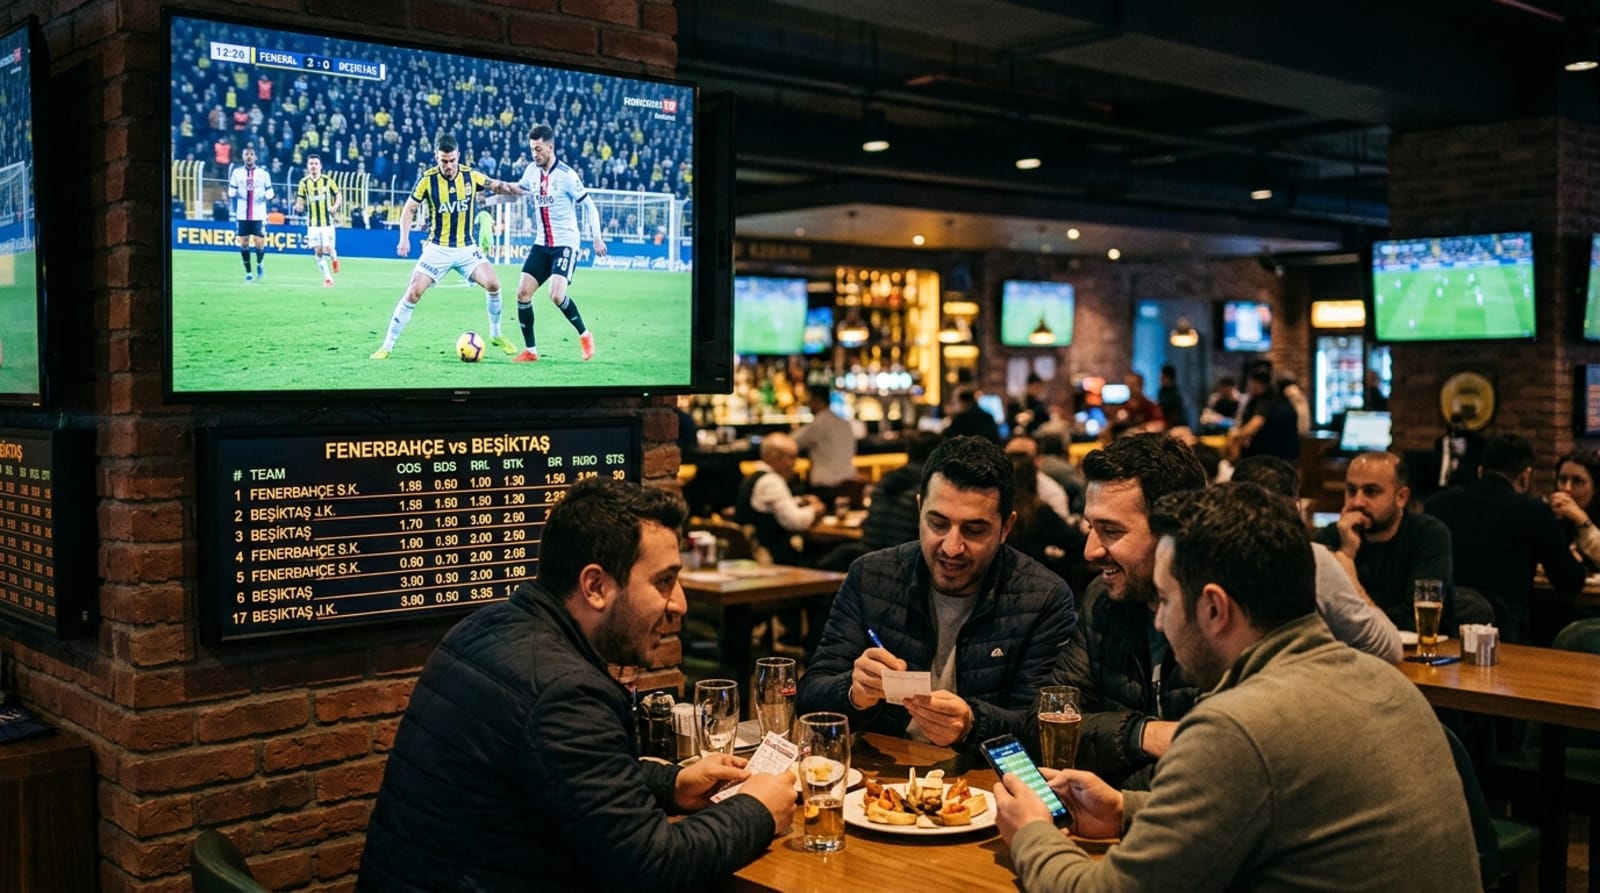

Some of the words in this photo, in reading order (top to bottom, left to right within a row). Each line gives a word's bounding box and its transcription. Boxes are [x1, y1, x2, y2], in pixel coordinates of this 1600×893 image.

[216, 47, 245, 60] 12:20
[323, 60, 330, 69] 0
[438, 200, 469, 214] AVIS
[326, 439, 445, 459] FENERBAHÇE
[448, 442, 467, 455] vs
[472, 434, 550, 456] BEŞİKTAŞ
[250, 468, 286, 480] TEAM
[433, 461, 457, 472] BDS
[606, 454, 625, 464] STS
[234, 489, 241, 501] 1
[250, 484, 335, 501] FENERBAHÇE
[234, 510, 243, 522] 2
[250, 505, 312, 522] BEŞİKTAŞ
[235, 530, 244, 543] 3
[251, 525, 312, 543] BEŞİKTAŞ
[236, 551, 244, 563] 4
[251, 544, 335, 561] FENERBAHÇE
[236, 571, 245, 583] 5
[252, 564, 336, 582] FENERBAHÇE
[237, 592, 245, 604] 6
[232, 612, 247, 624] 17
